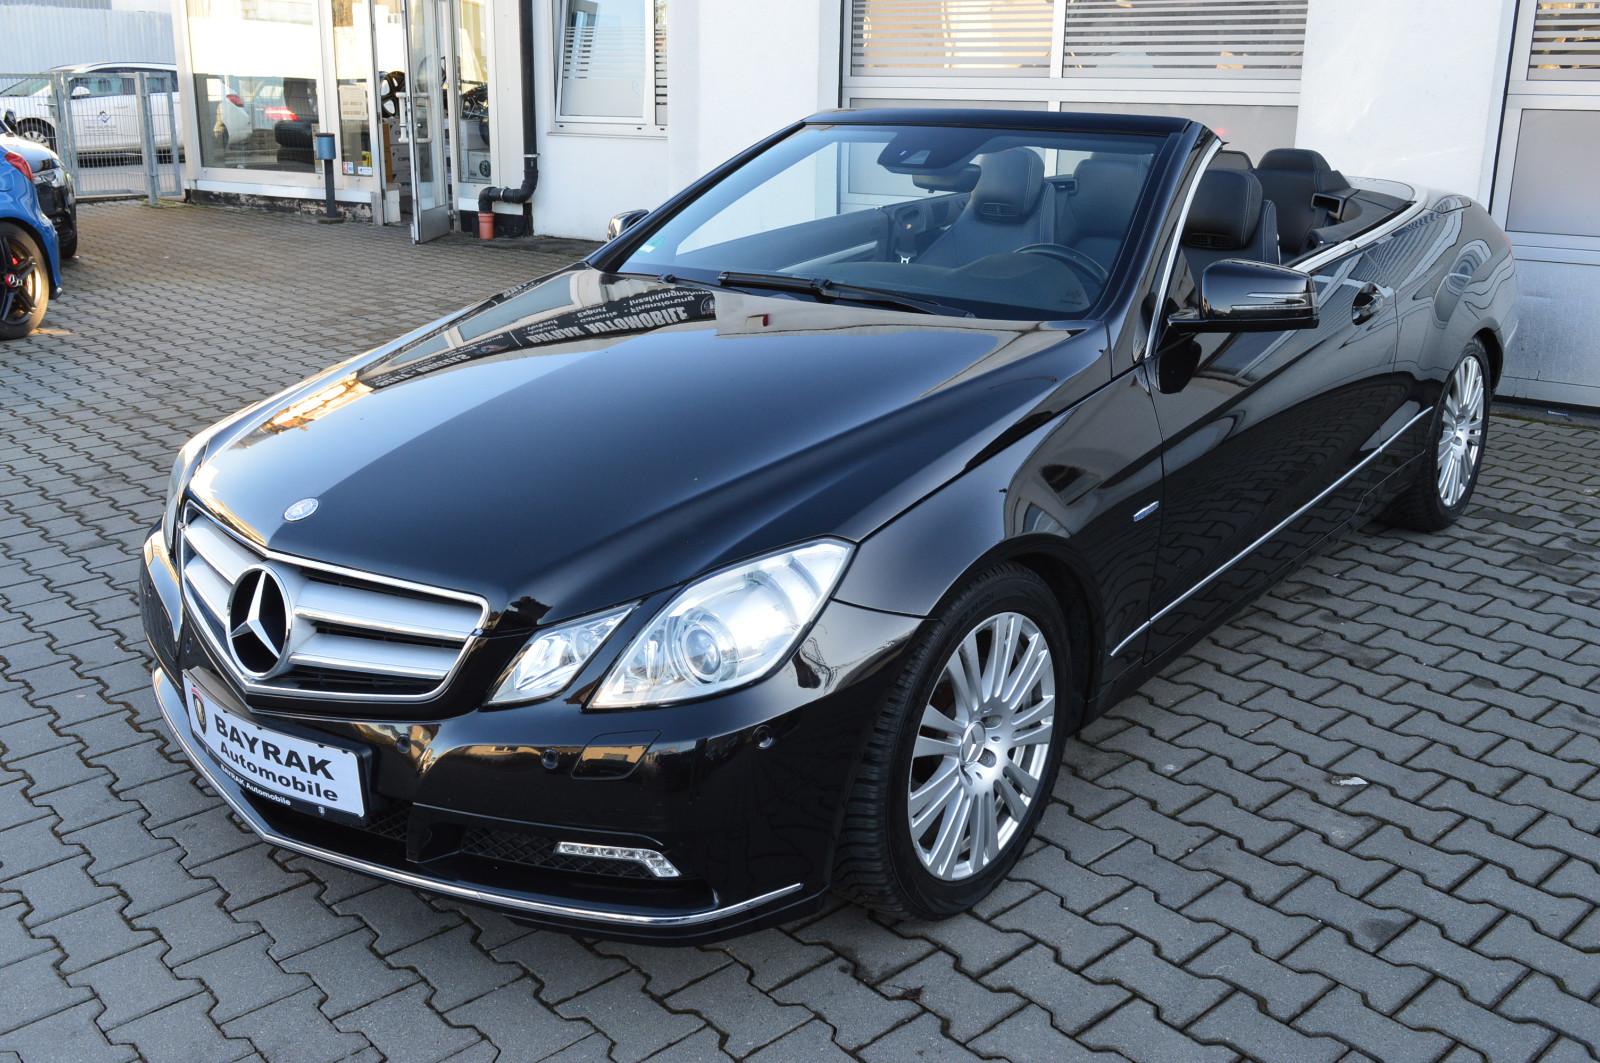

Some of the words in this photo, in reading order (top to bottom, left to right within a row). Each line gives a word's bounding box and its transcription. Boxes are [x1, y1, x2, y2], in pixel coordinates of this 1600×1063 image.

[214, 713, 335, 781] BAYRAK
[220, 741, 339, 802] Automobile
[246, 782, 292, 806] Automobile
